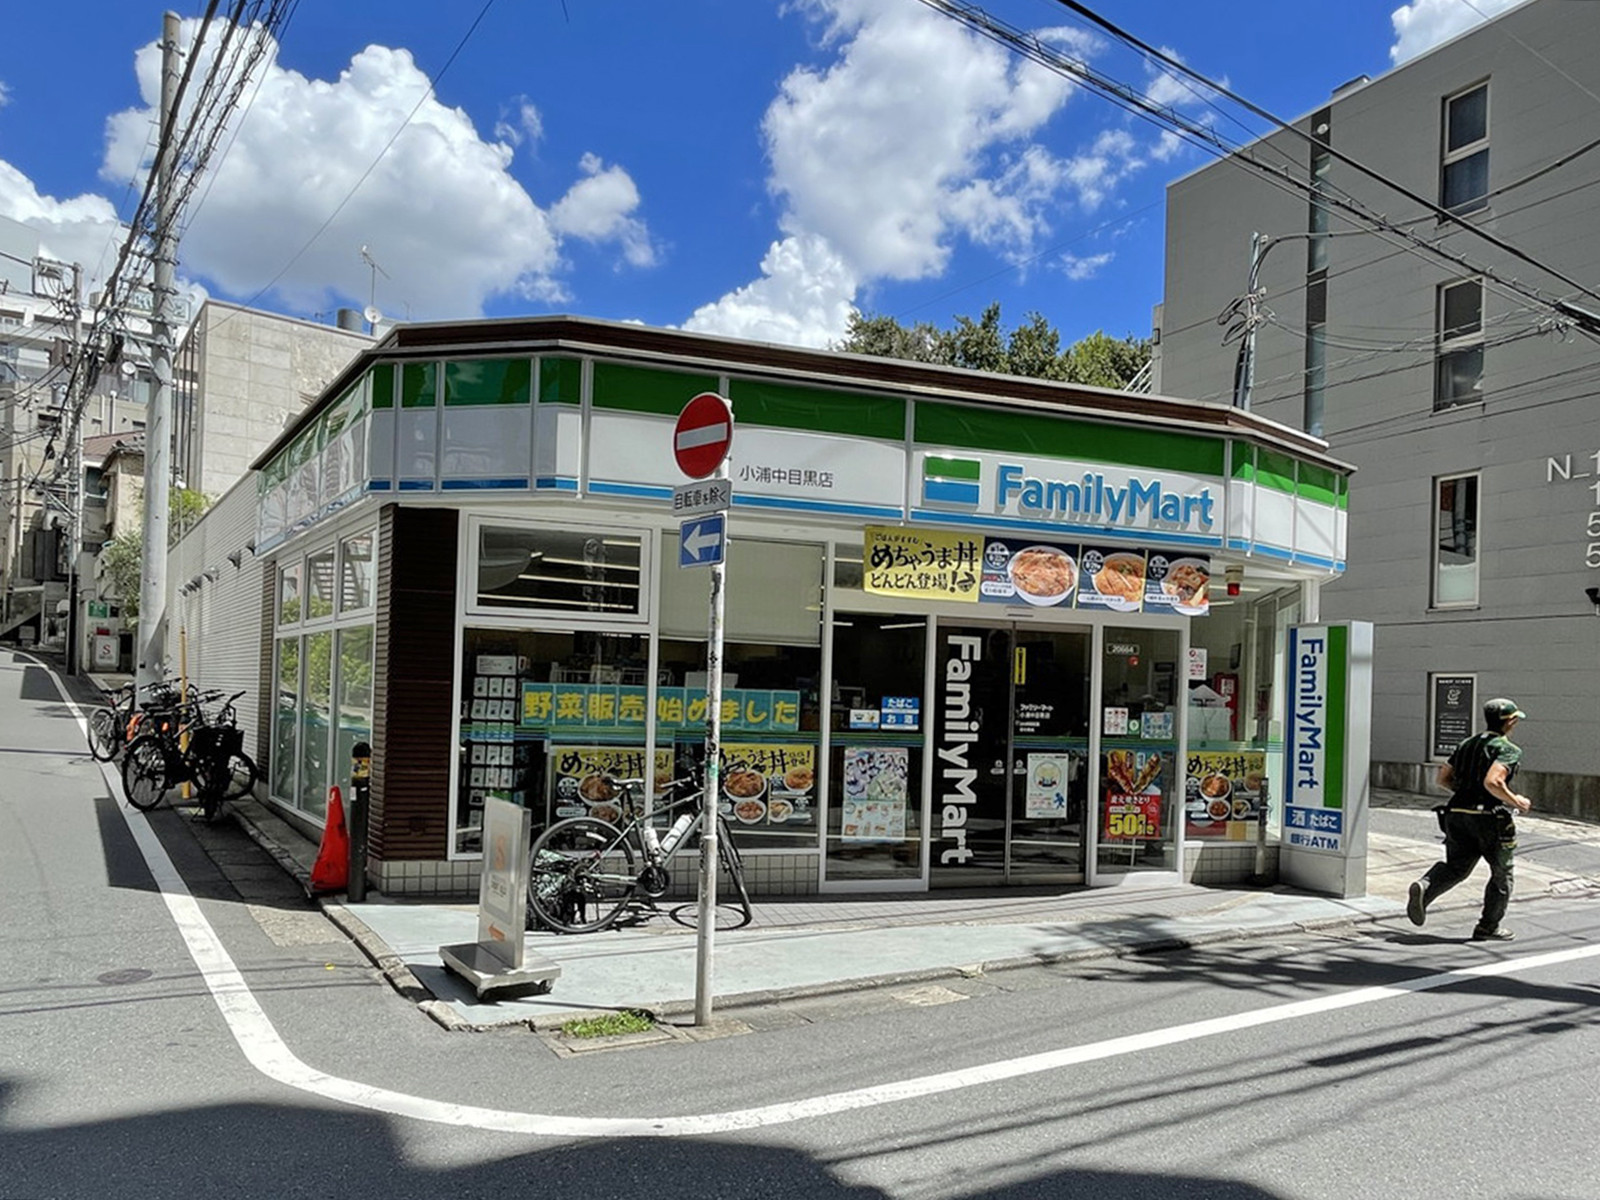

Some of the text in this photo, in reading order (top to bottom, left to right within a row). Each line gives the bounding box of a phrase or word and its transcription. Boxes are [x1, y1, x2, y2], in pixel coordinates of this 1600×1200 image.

[739, 465, 834, 488] 小浦中目黒店
[674, 486, 727, 510] 自転車を除く
[998, 464, 1214, 526] FamilyMart
[870, 541, 978, 572] めちゃうま丼
[524, 692, 798, 724] 野菜販売始めました
[1296, 638, 1324, 789] FamilyMart
[938, 634, 982, 864] FamilyMart
